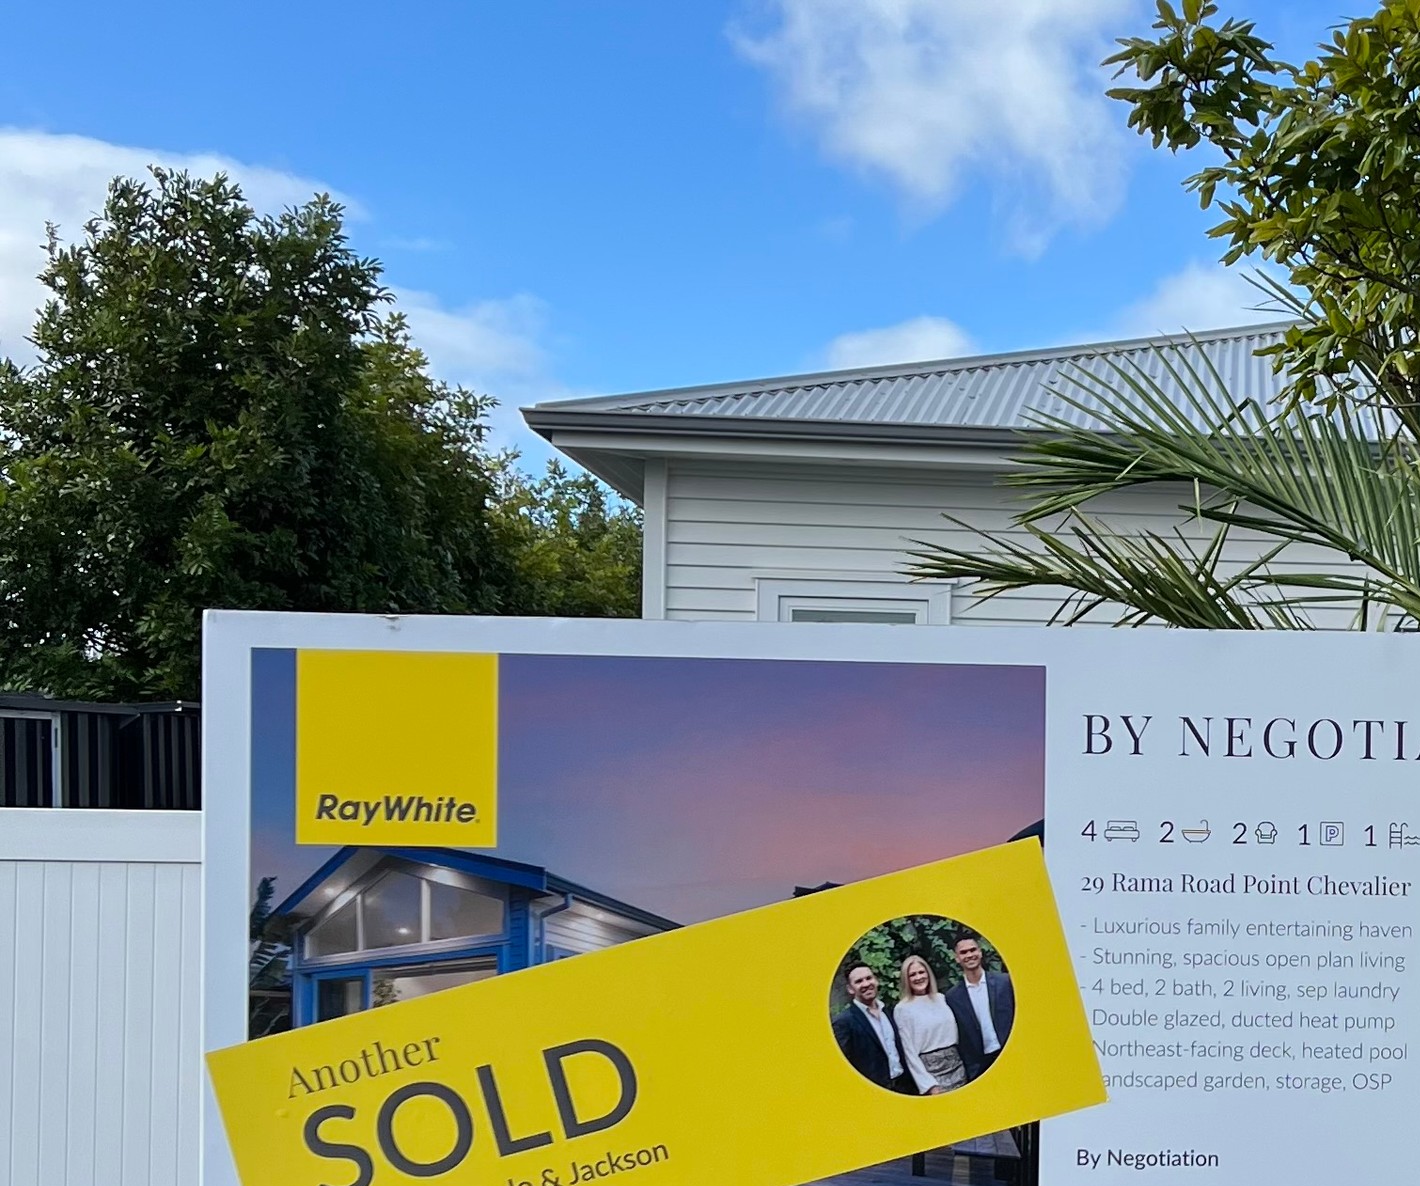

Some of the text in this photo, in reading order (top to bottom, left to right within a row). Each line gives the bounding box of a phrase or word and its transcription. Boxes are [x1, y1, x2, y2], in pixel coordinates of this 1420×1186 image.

[1083, 715, 1152, 755] BY
[1081, 819, 1098, 842] 4
[1159, 821, 1175, 843] 2
[1232, 822, 1248, 845] 2
[1298, 823, 1311, 846] 1
[1364, 824, 1377, 847] 1
[1081, 872, 1412, 897] 29 Rama Road Point Chevalier
[1094, 917, 1181, 935] Luxurious
[1187, 917, 1241, 940] family
[1245, 920, 1354, 942] entertaining
[1359, 921, 1413, 939] haven
[1092, 947, 1177, 970] Stunning,
[1183, 949, 1260, 969] spacious
[1265, 953, 1311, 970] open
[1317, 950, 1354, 971] plan
[1360, 951, 1406, 973] living
[1091, 978, 1105, 995] 4
[1110, 978, 1149, 998] bed,
[1154, 978, 1166, 996] 2
[1172, 978, 1217, 999] bath,
[1223, 979, 1234, 997] 2
[1241, 979, 1291, 1002] living,
[1297, 985, 1328, 1001] sep
[1334, 981, 1401, 1002] laundry
[1092, 1008, 1396, 1033] Double glazed, ducted heat pump
[1091, 1038, 1408, 1064] Northeast-facing deck, heated pool
[288, 1036, 441, 1098] Another
[1101, 1069, 1392, 1094] andscaped garden, storage, OSP
[570, 1145, 668, 1185] Jackson
[1076, 1148, 1219, 1171] By Negotiation
